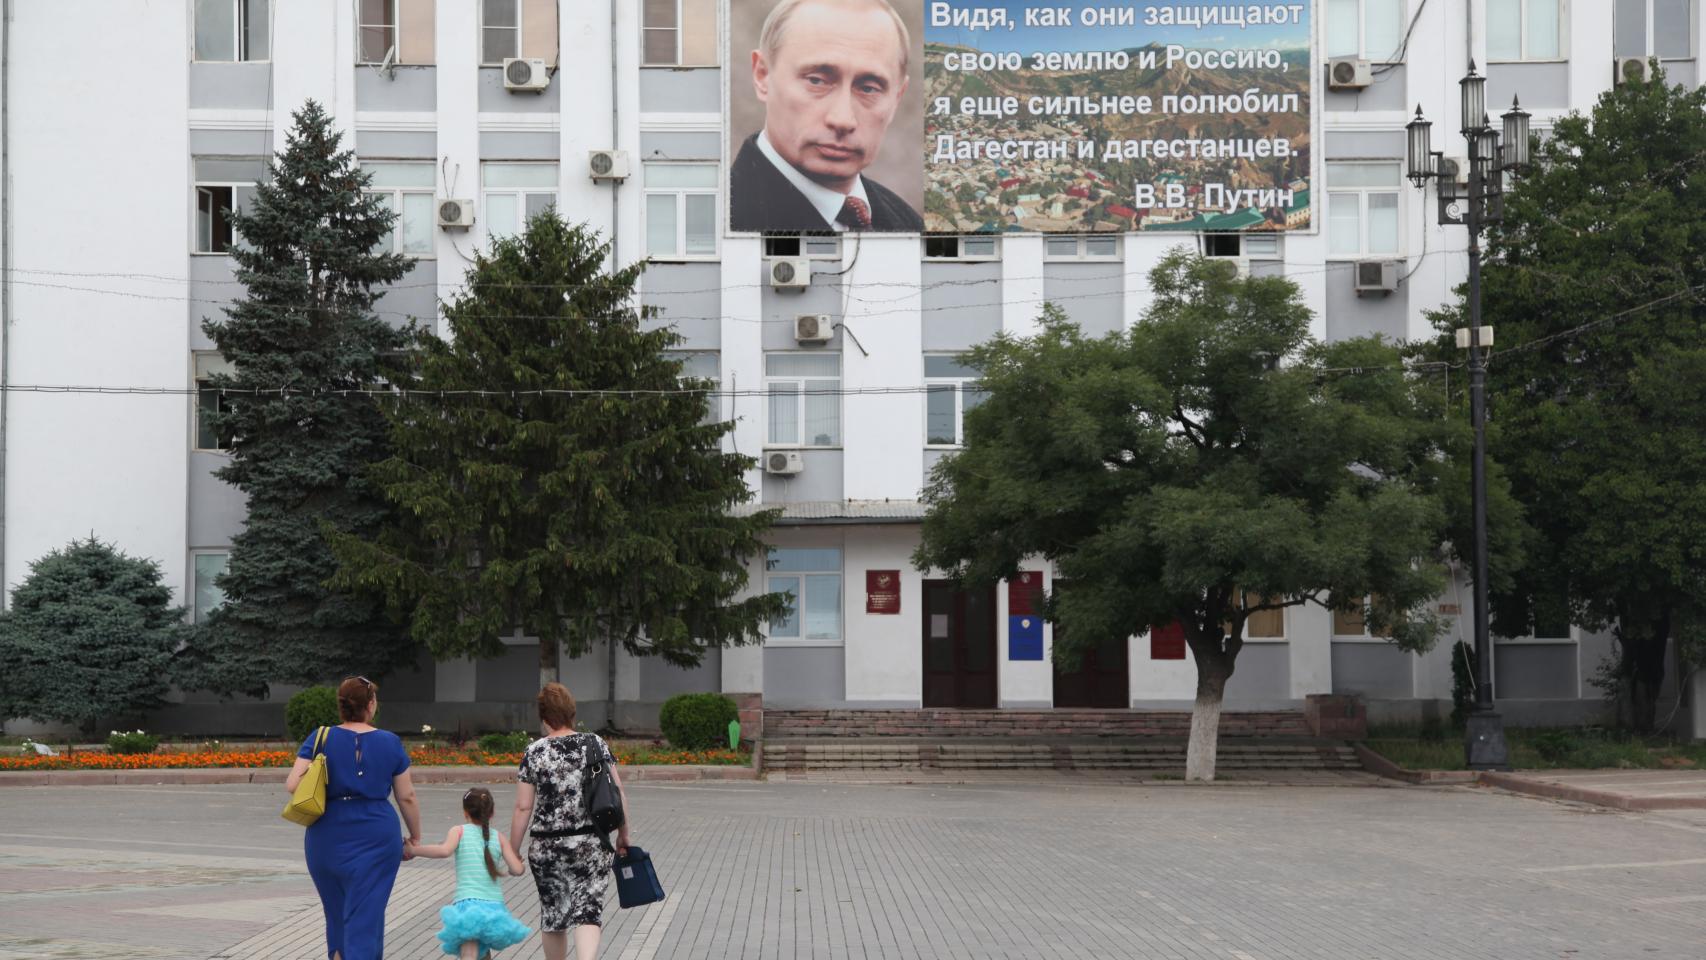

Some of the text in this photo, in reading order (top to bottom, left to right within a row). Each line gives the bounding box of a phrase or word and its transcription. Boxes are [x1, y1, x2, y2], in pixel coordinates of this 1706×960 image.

[931, 2, 1303, 30] Видя, как они защищают
[943, 45, 1289, 72] свою землю и Россию,
[933, 88, 1299, 119] я еще сильнее полюбил
[933, 134, 1298, 163] Дагестан и дагестанцев.
[1135, 183, 1294, 214] В.В. Путин
